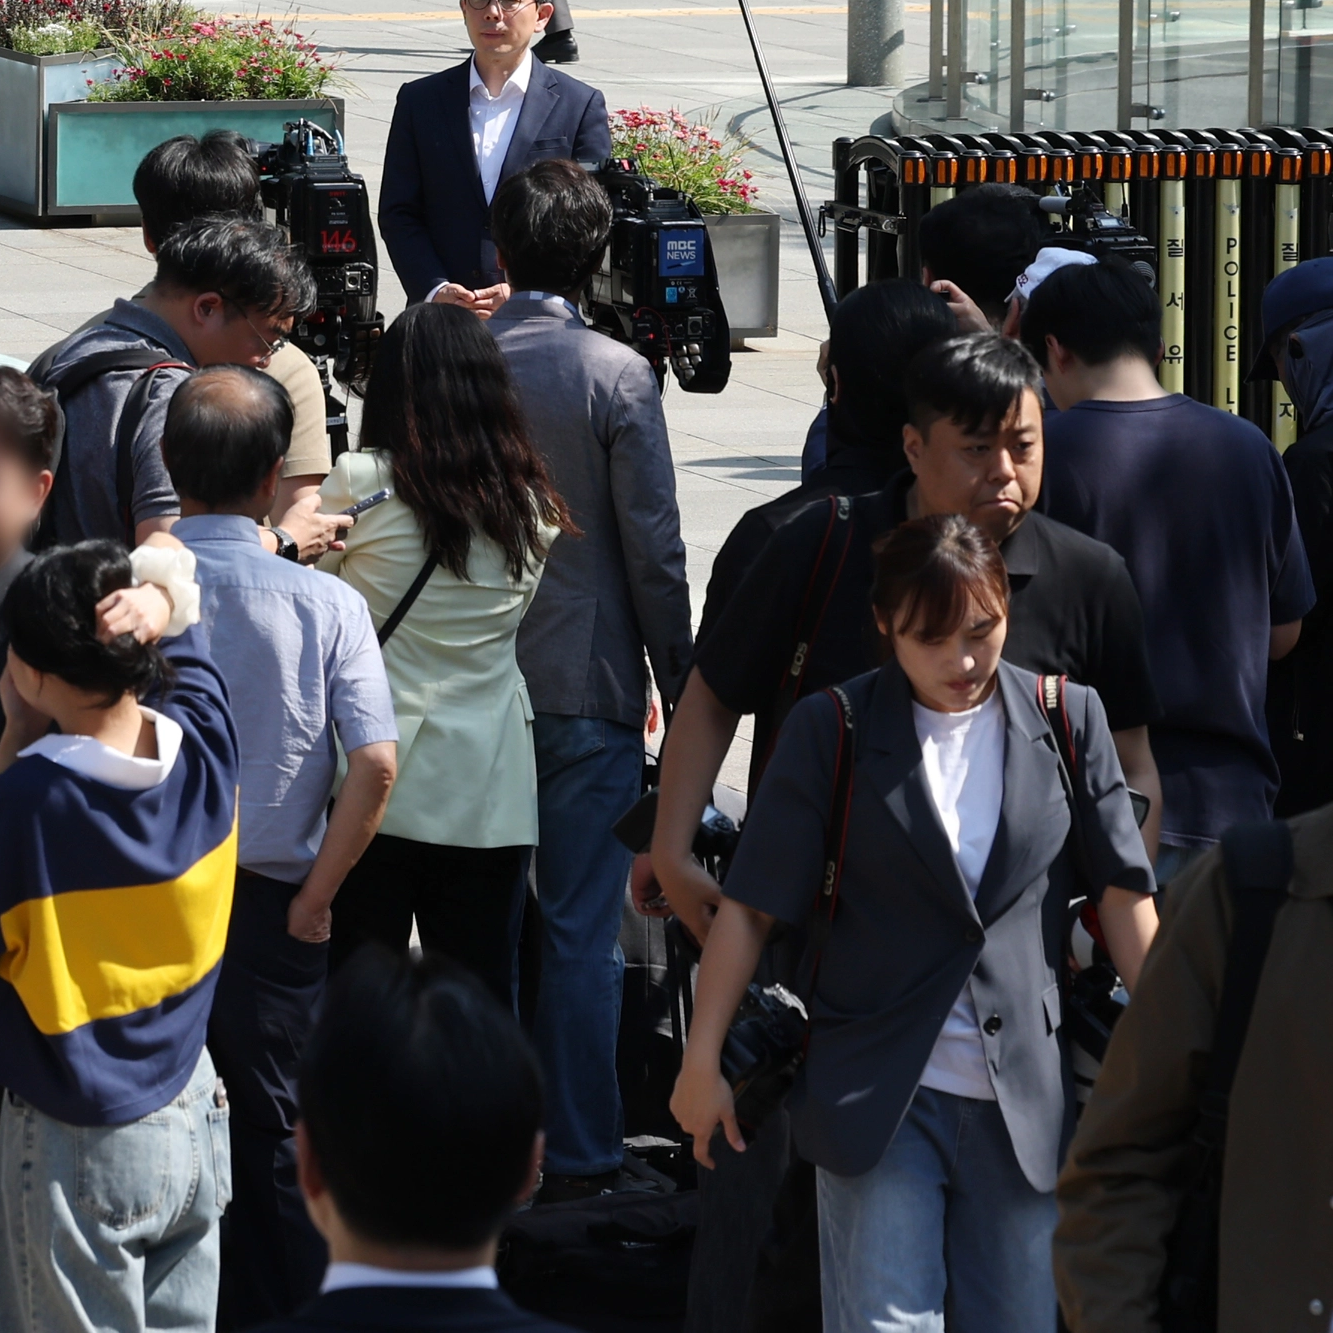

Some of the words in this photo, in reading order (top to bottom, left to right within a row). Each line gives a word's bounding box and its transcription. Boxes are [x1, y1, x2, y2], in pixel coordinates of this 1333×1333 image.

[320, 229, 358, 254] 146
[667, 251, 696, 260] NEWS
[1164, 239, 1184, 365] 질서유
[1223, 237, 1239, 362] POLICE
[789, 641, 808, 677] EOS
[823, 859, 836, 897] EOS
